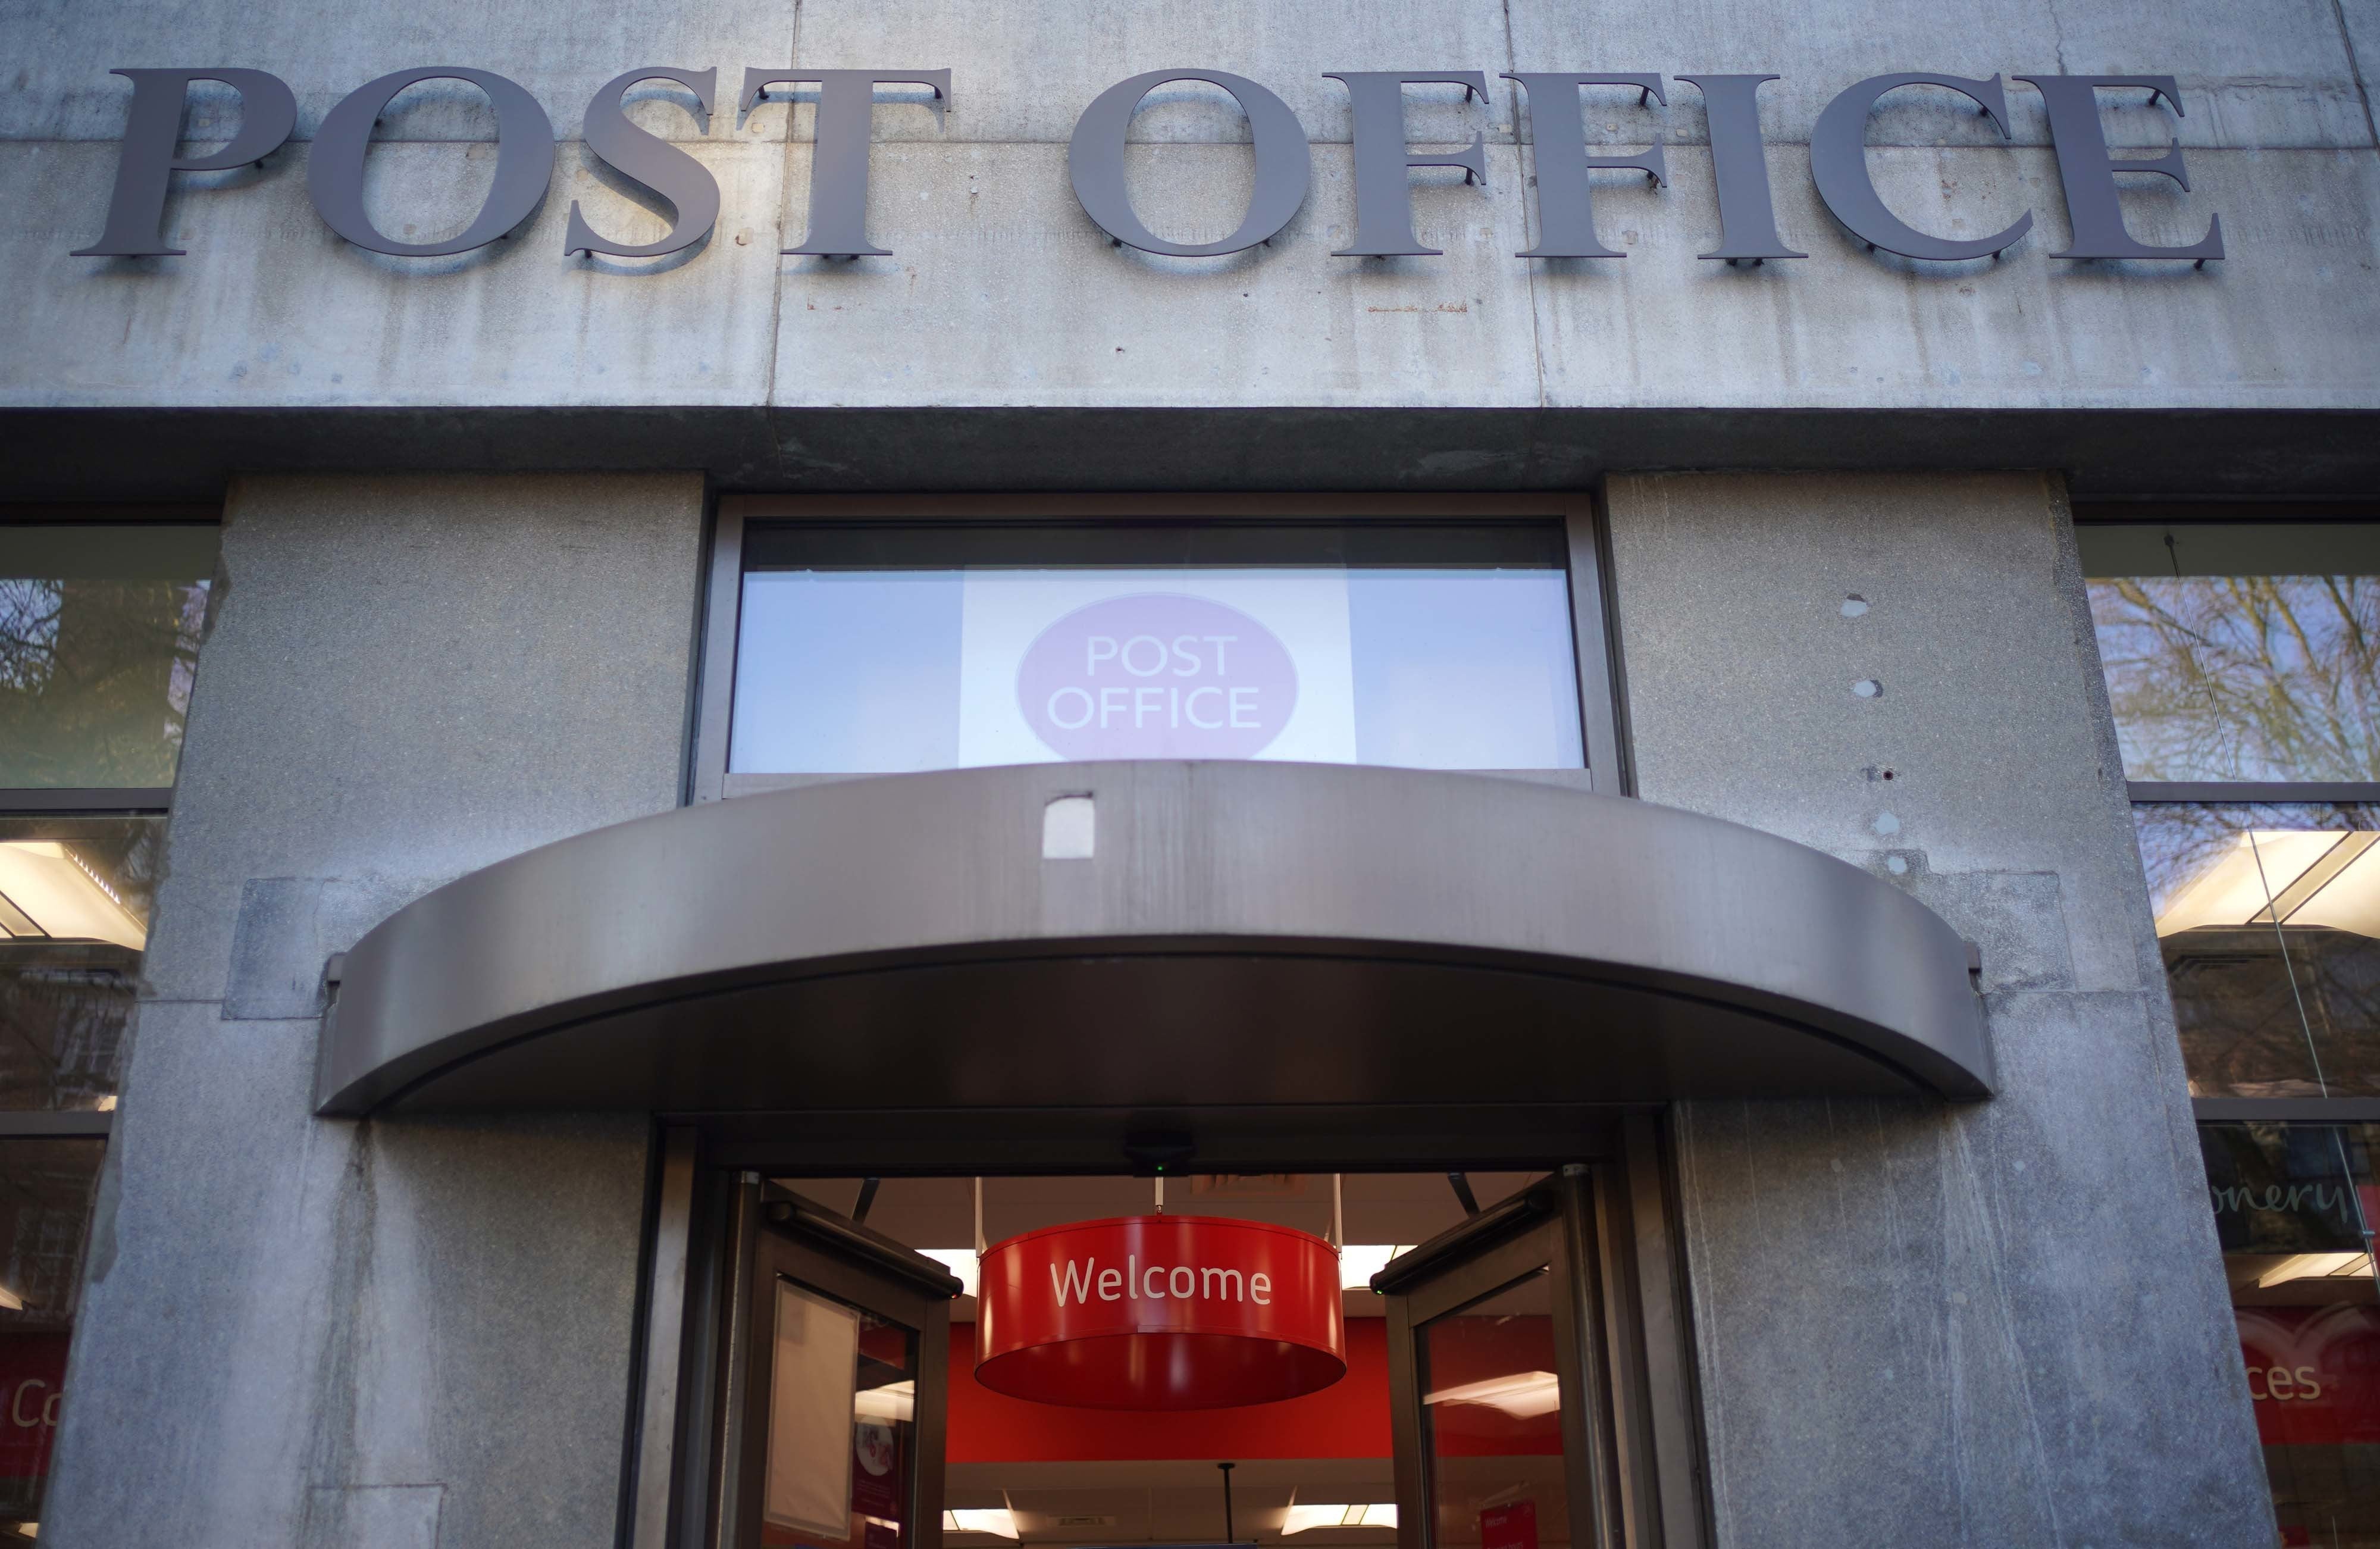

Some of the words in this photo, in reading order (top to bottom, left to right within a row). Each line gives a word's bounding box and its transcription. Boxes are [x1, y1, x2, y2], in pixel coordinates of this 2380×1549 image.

[70, 65, 951, 257] POST
[1067, 67, 2225, 261] OFFICE
[1086, 634, 1238, 677] POST
[1047, 686, 1262, 730] OFFICE
[1050, 1254, 1271, 1307] Welcome
